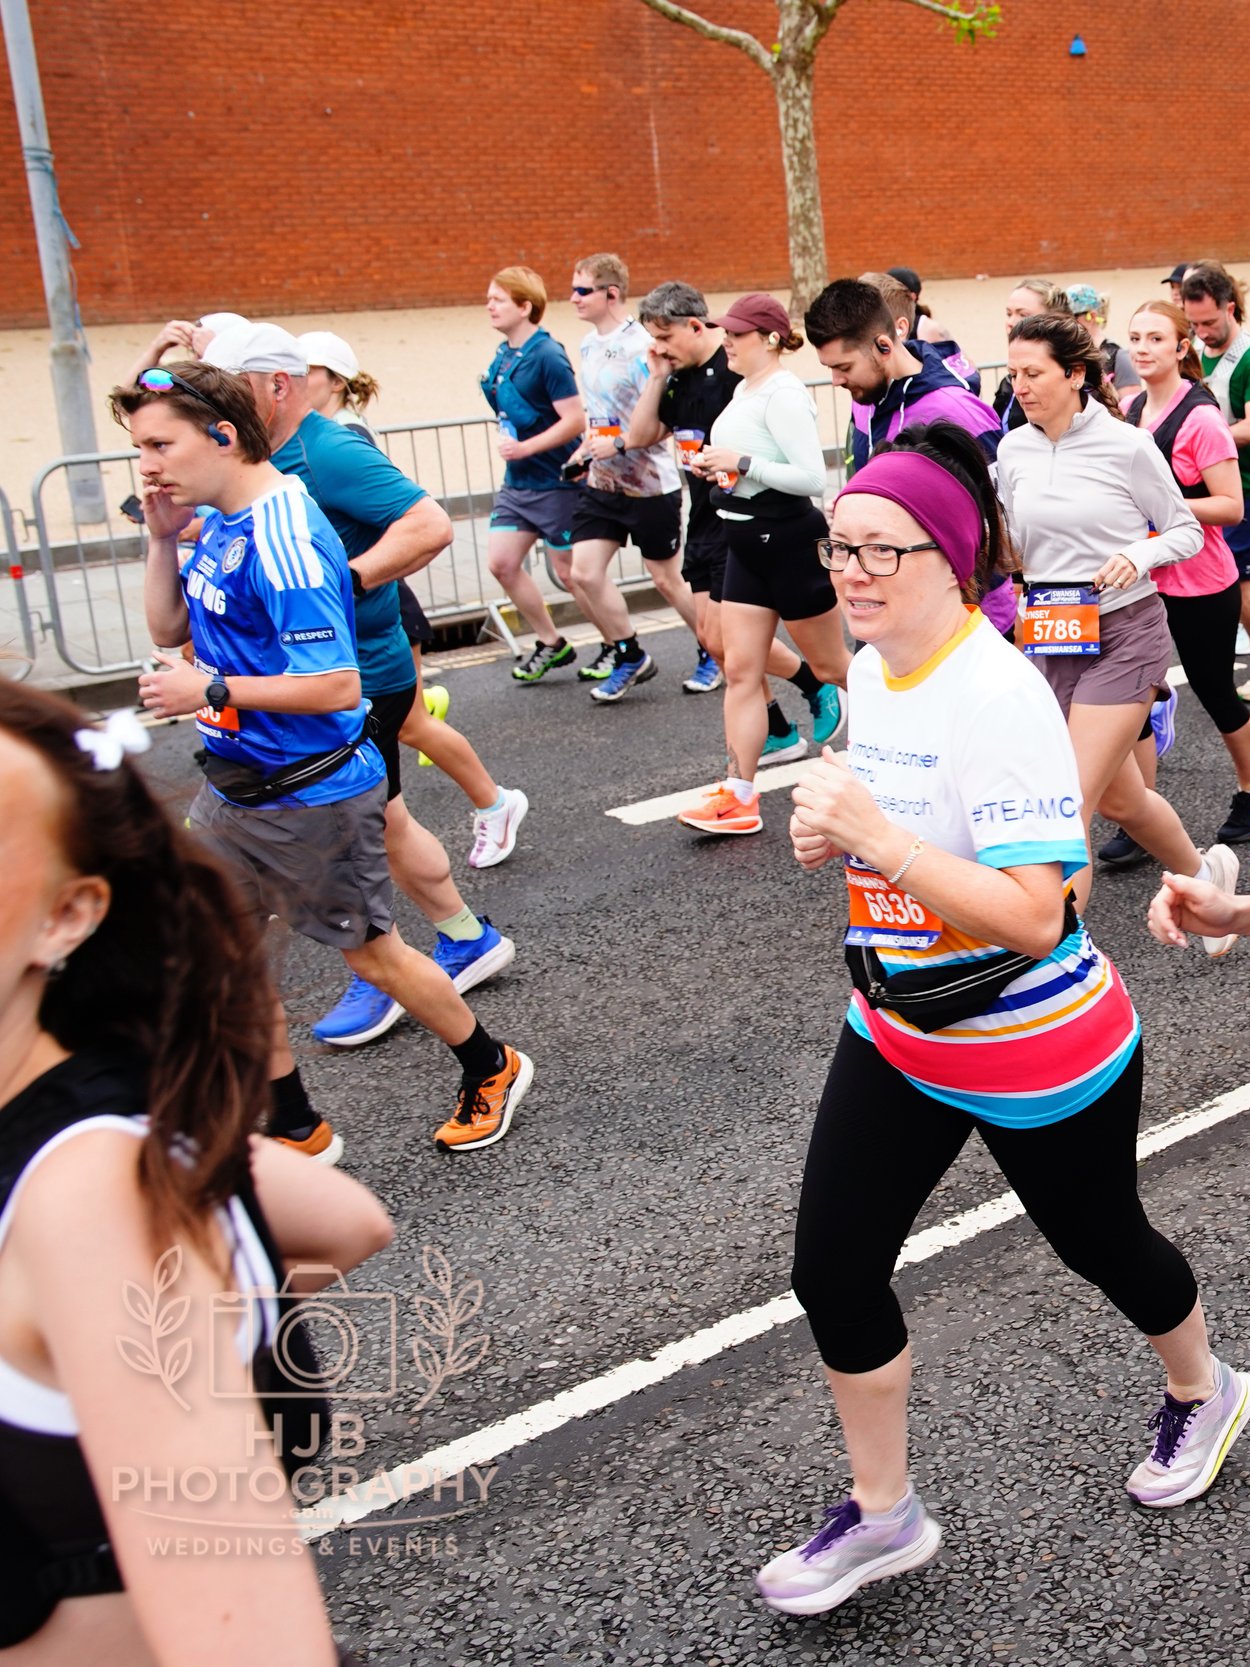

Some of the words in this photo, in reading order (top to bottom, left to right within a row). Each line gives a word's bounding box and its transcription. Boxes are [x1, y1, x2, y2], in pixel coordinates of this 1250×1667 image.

[294, 629, 334, 642] RESPECT
[1033, 619, 1082, 641] 5786
[971, 796, 1077, 823] #TEAMC
[863, 891, 926, 925] 6936
